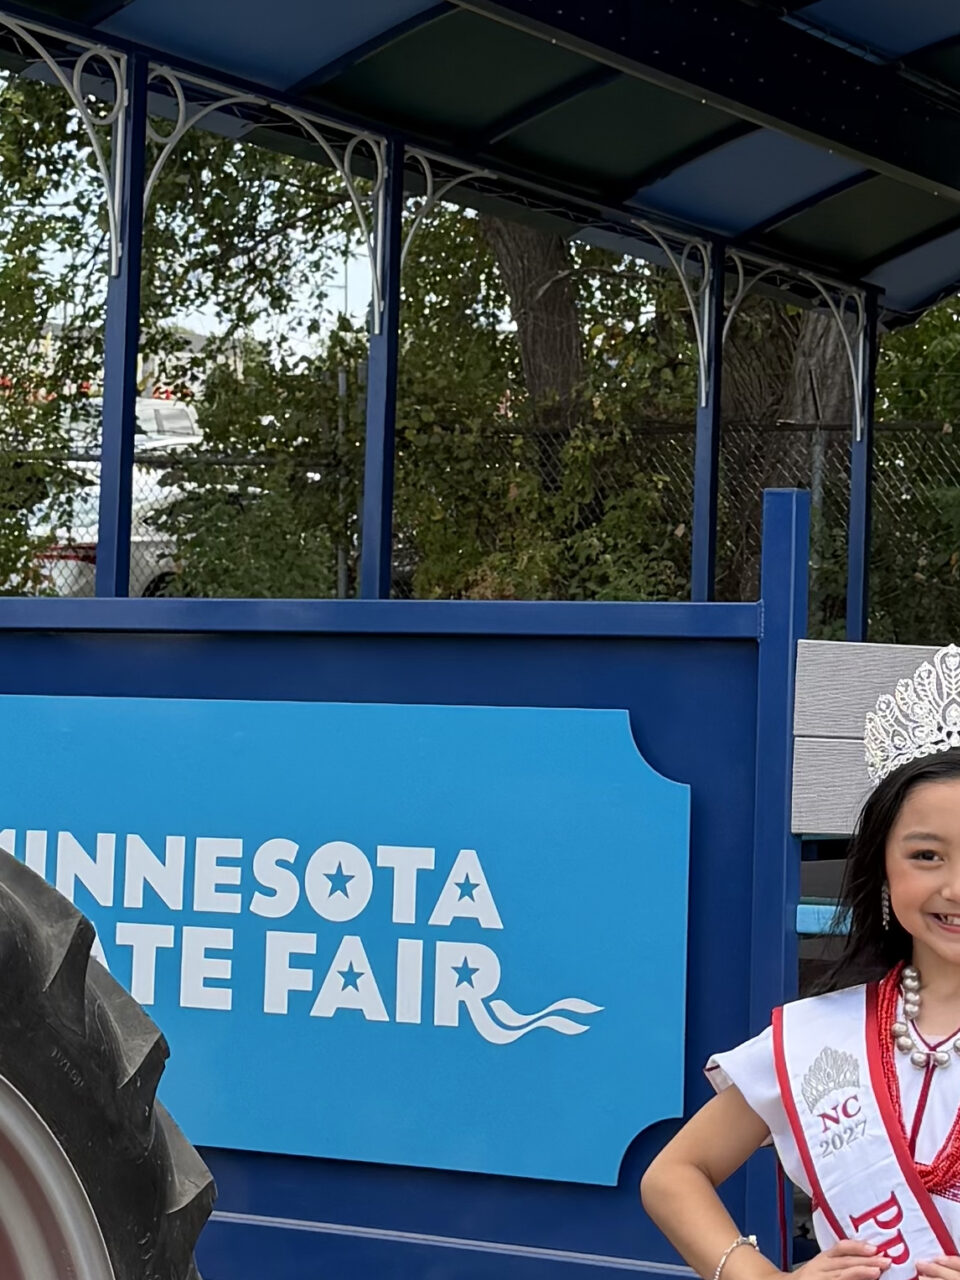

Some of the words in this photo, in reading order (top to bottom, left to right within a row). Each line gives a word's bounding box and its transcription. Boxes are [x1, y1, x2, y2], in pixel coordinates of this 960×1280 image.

[264, 930, 604, 1044] FAIR
[817, 1094, 862, 1133] NC
[819, 1119, 867, 1158] 2027
